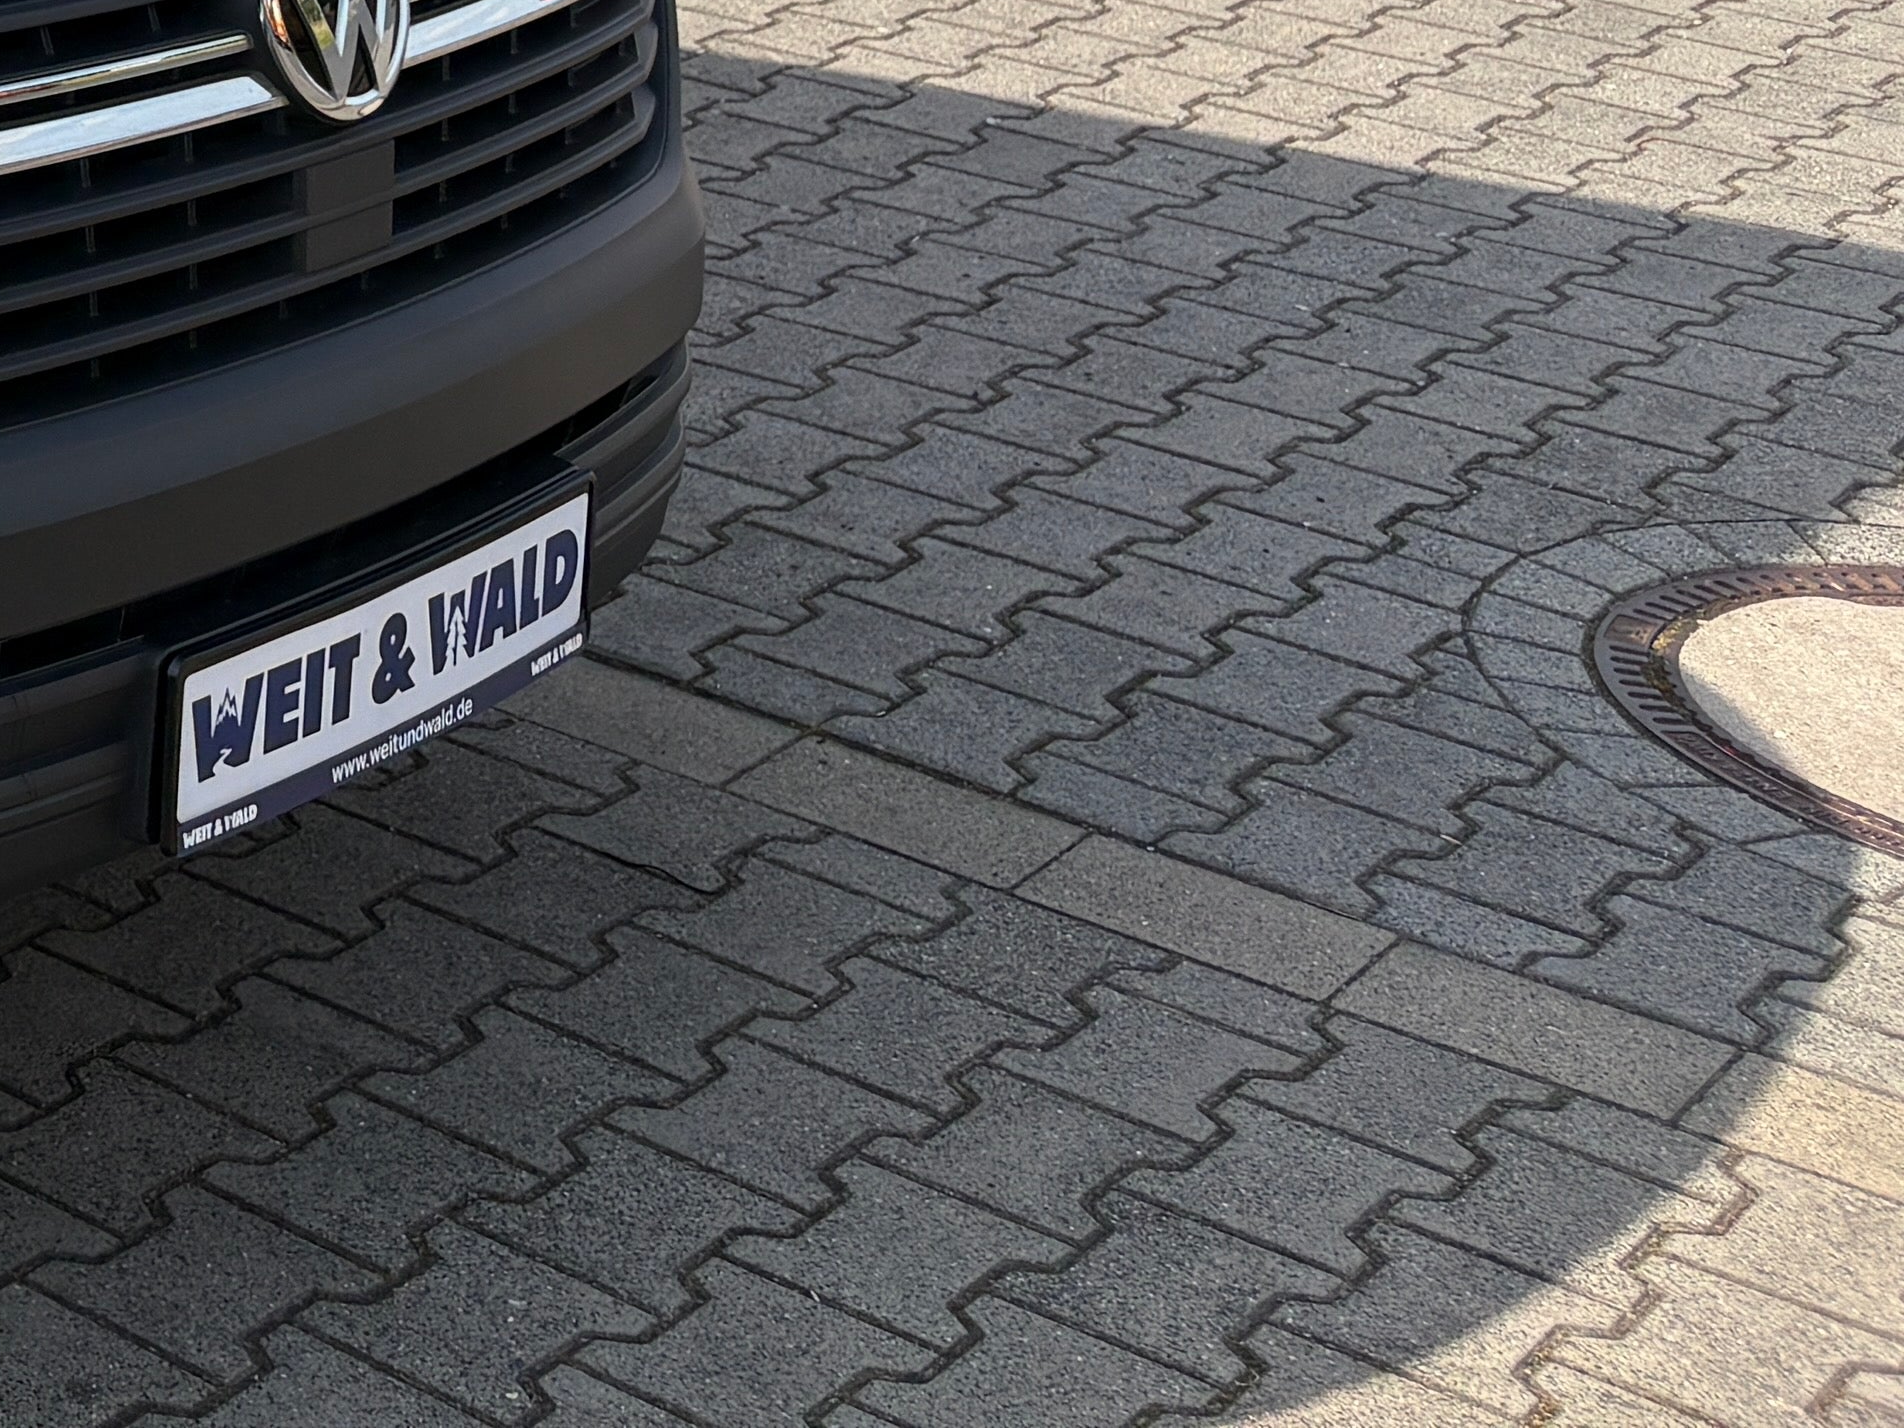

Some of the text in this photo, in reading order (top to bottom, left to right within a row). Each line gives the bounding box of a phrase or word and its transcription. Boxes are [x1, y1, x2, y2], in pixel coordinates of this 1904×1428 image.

[192, 528, 579, 783] WEIT & WALD
[331, 697, 473, 783] www.weitundwald.de
[182, 822, 212, 849] WEIT
[224, 804, 258, 832] WALD
